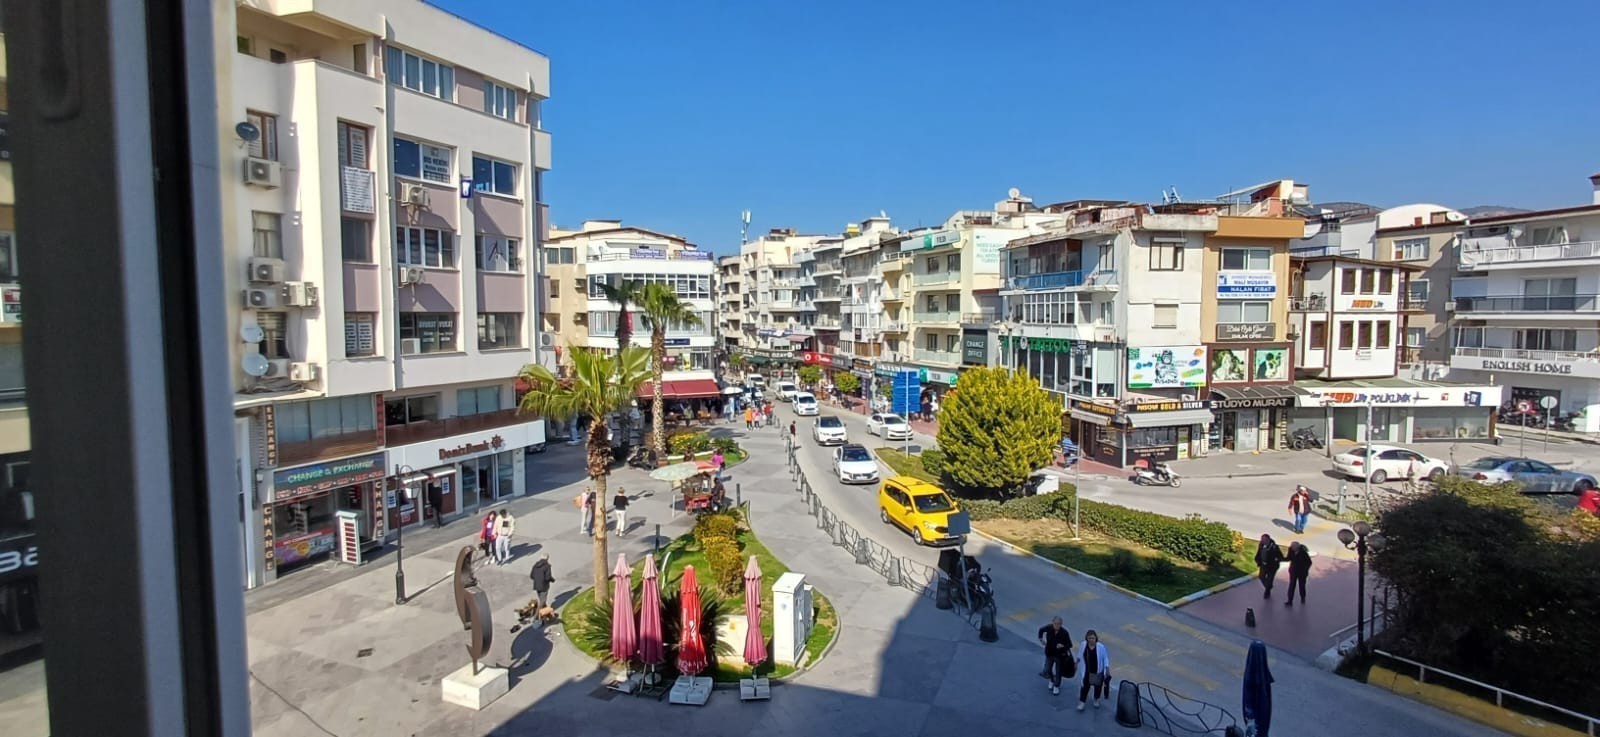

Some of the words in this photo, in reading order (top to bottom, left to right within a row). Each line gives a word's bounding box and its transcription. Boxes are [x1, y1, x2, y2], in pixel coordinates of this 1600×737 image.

[967, 340, 984, 349] CHANGE
[967, 350, 983, 358] OFFICE
[1482, 360, 1530, 372] ENGLISH
[1534, 362, 1572, 374] HOME
[1183, 401, 1203, 409] SILVER
[1210, 399, 1251, 409] STUDYO
[1252, 398, 1288, 407] MURAT
[287, 468, 324, 484] CHANGE
[375, 481, 383, 537] CHANGE
[263, 506, 274, 570] CHANGE
